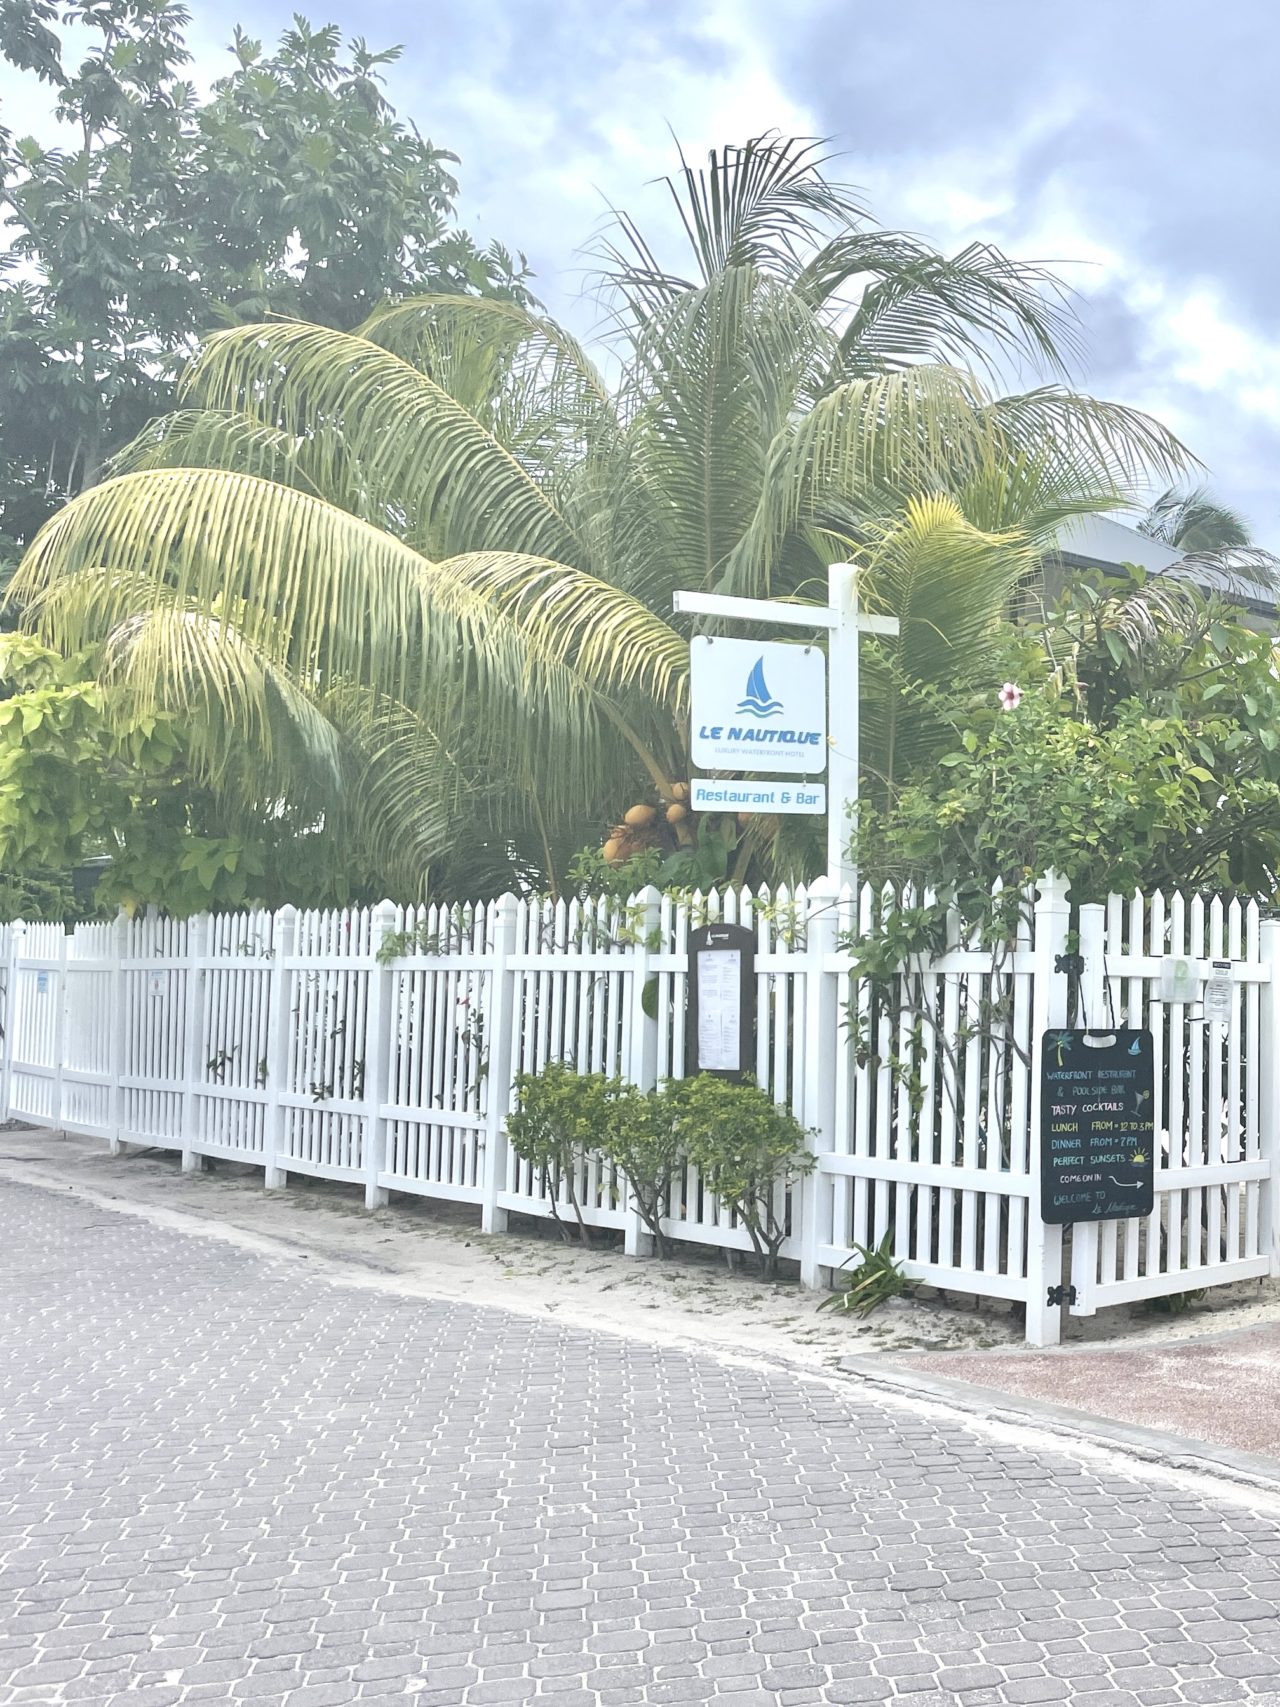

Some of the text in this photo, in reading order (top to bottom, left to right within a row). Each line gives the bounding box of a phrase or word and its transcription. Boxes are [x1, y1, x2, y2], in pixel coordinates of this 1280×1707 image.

[699, 726, 821, 745] LE NAUTIQUE
[741, 748, 784, 757] WATERFRONT
[696, 788, 821, 805] Restaurant & Bar
[1046, 1070, 1093, 1080] WATERFRONT
[1051, 1102, 1124, 1116] TASTY COCKTAILS
[1051, 1122, 1079, 1132] LUNCH
[1091, 1121, 1113, 1131] FROM
[1051, 1139, 1082, 1150] DINNER
[1090, 1137, 1113, 1147] FROM
[1053, 1154, 1126, 1167] PERFECT SUNSETS
[1060, 1173, 1102, 1184] COME ON IN
[1053, 1190, 1106, 1206] WELCOME TO
